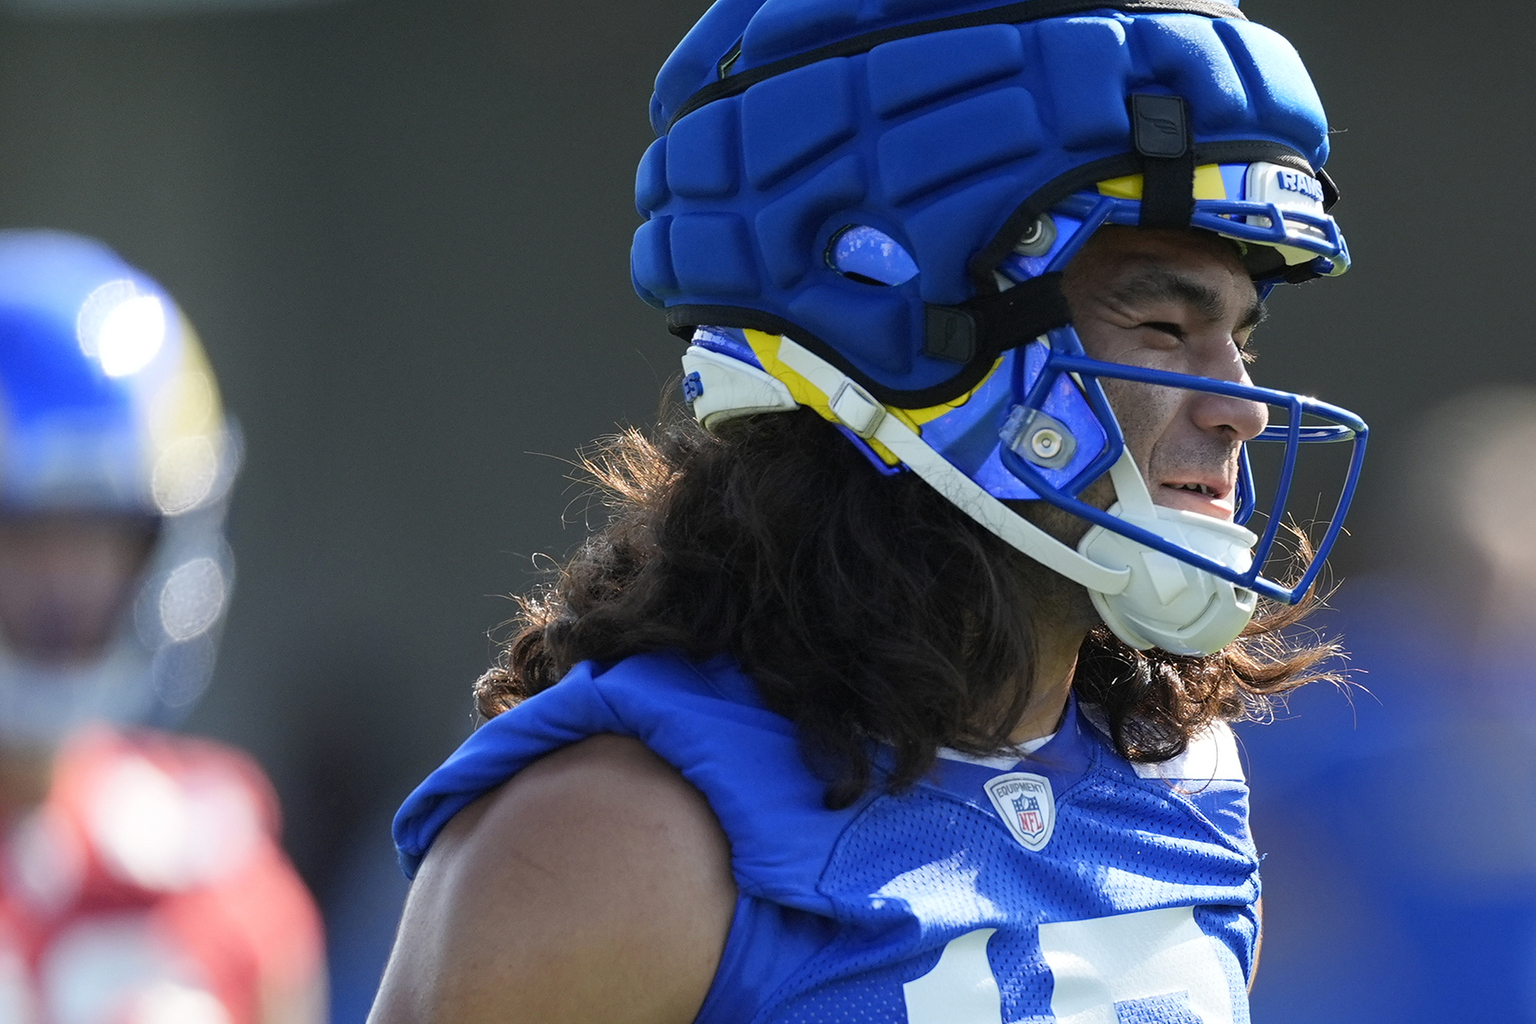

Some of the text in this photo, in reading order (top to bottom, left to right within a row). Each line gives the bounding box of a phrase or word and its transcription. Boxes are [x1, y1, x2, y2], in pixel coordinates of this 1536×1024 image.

[1277, 171, 1324, 202] RAMS
[996, 782, 1044, 798] EQUIPMENT
[1018, 811, 1043, 833] NFL
